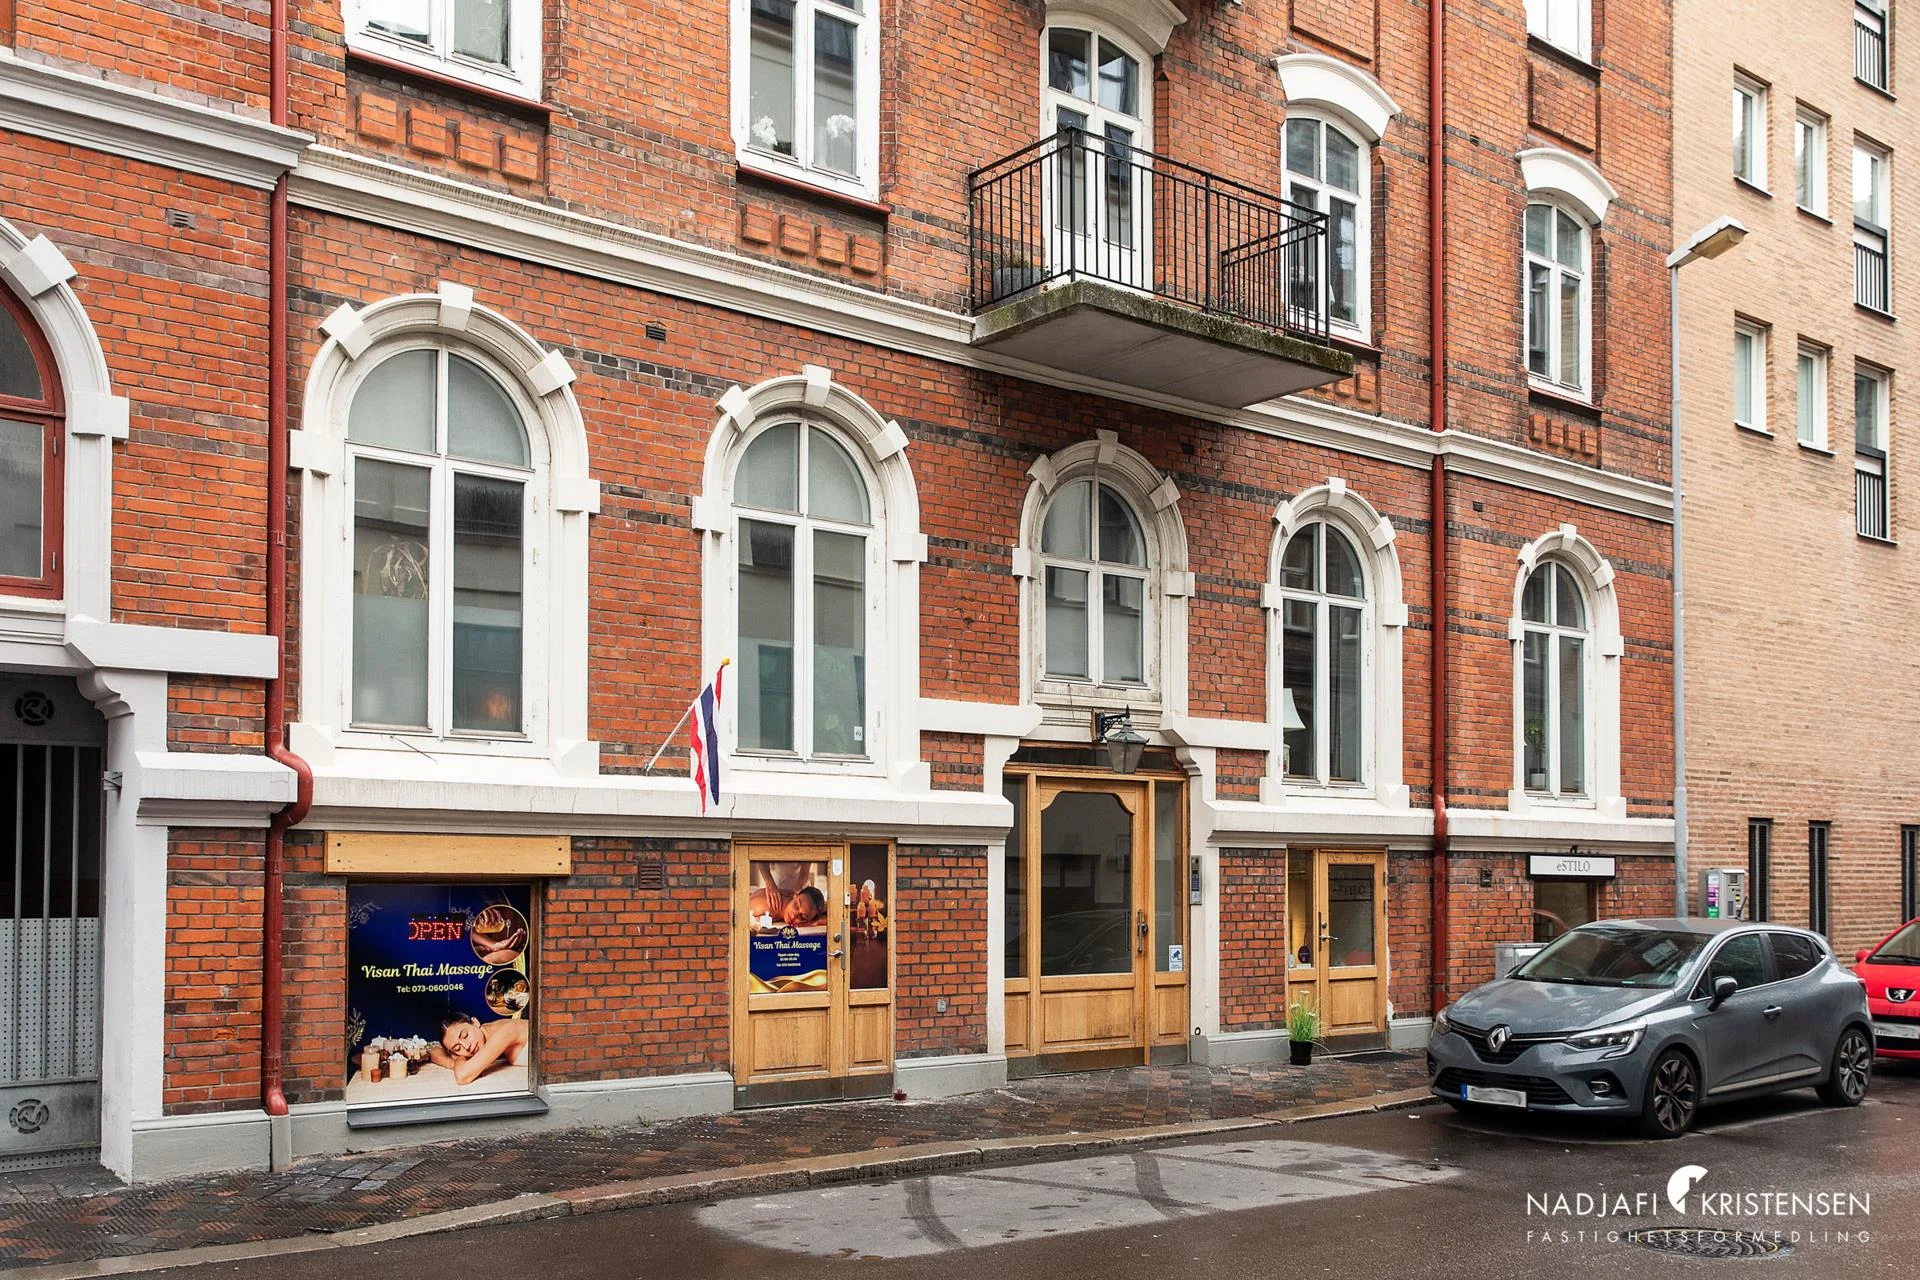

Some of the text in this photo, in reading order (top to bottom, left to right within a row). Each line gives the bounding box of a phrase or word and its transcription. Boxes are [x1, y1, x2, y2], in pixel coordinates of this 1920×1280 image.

[1556, 860, 1591, 872] eSTILO
[753, 940, 821, 951] Yisan Thai Massage
[361, 963, 494, 979] Yisan Thai Massage
[397, 983, 464, 993] Tel: 073-0600046
